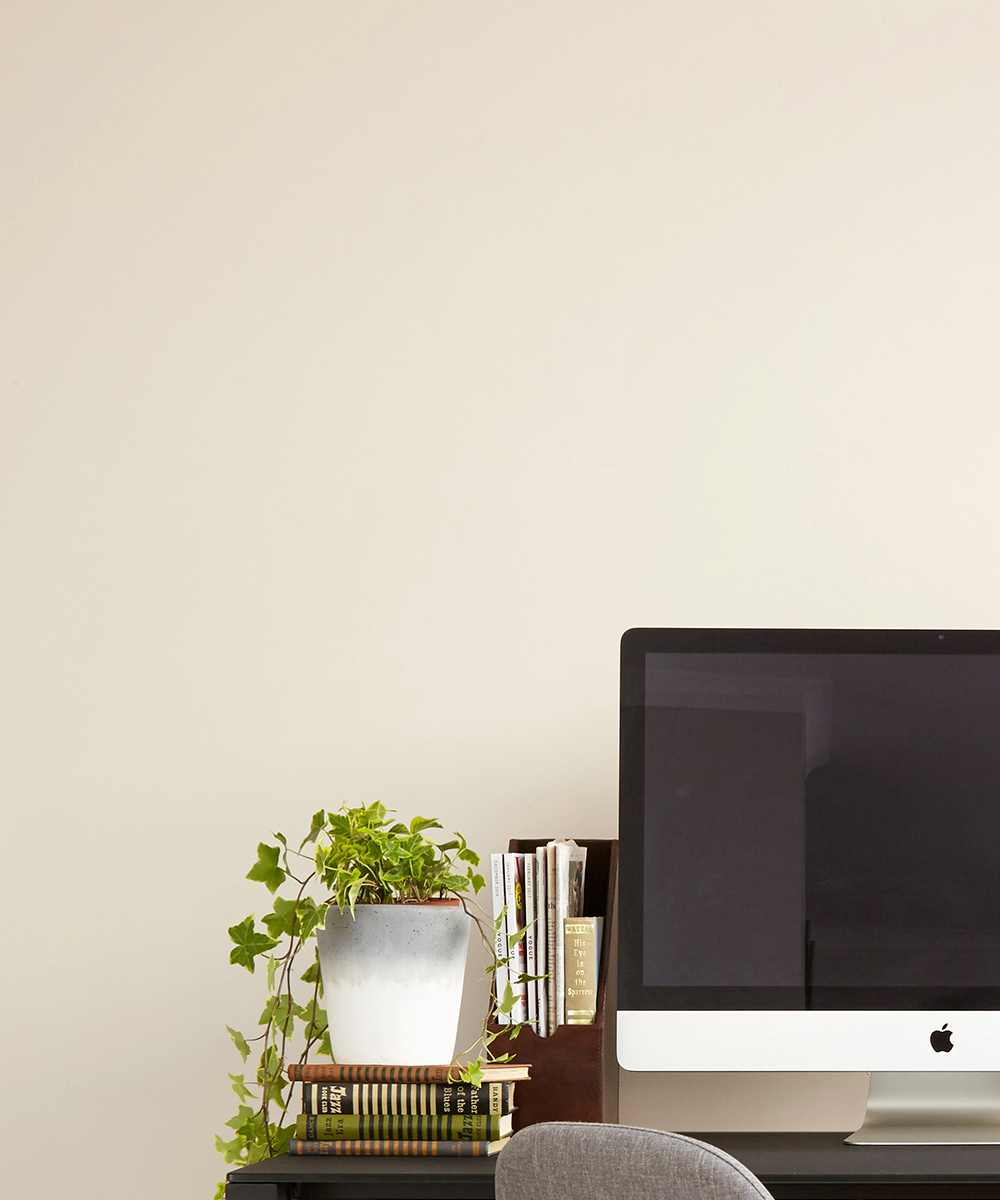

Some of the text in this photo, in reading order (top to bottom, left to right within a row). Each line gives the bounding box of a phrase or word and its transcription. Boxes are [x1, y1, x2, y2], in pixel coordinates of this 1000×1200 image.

[573, 949, 586, 959] Eye
[574, 939, 586, 947] His
[574, 978, 586, 986] the
[329, 1085, 347, 1114] Jazz
[443, 1087, 452, 1113] Blues
[457, 1086, 466, 1113] of the
[471, 1085, 479, 1114] Father
[324, 1117, 333, 1137] Jazz
[336, 1118, 344, 1136] Era
[457, 1115, 473, 1141] Jazz
